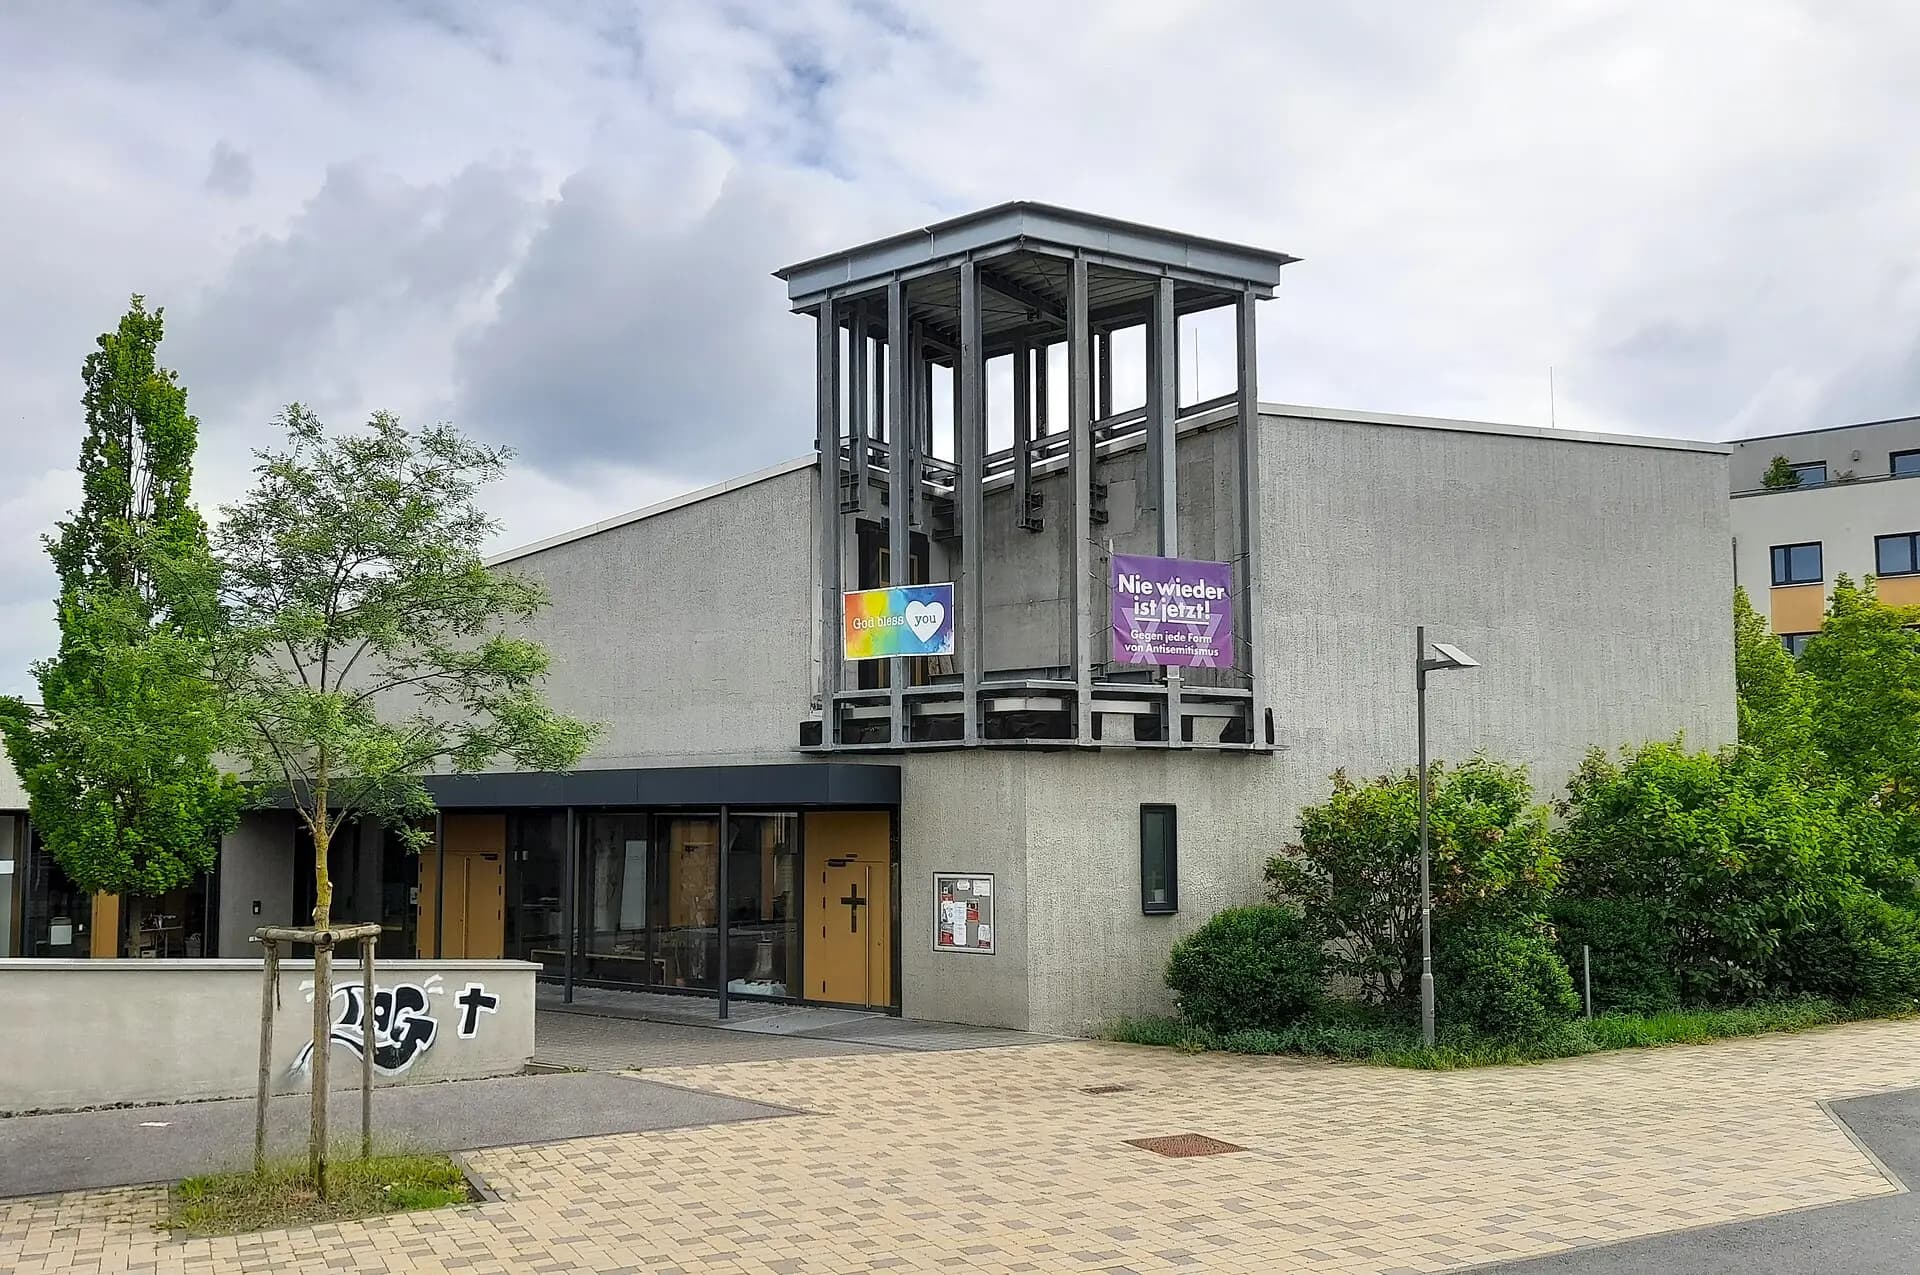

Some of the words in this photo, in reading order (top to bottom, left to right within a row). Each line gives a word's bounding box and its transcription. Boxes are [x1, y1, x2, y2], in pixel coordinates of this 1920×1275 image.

[1118, 573, 1153, 595] Nie
[1156, 577, 1225, 600] wieder
[1134, 595, 1157, 616] ist
[1161, 597, 1210, 622] jetzt!
[853, 617, 874, 629] God
[878, 616, 904, 627] bless
[914, 615, 937, 627] you
[1130, 630, 1163, 642] Gegen
[1165, 631, 1186, 643] jede
[1188, 633, 1213, 644] Form
[1124, 644, 1144, 653] von
[1145, 643, 1219, 657] Antisemitismus
